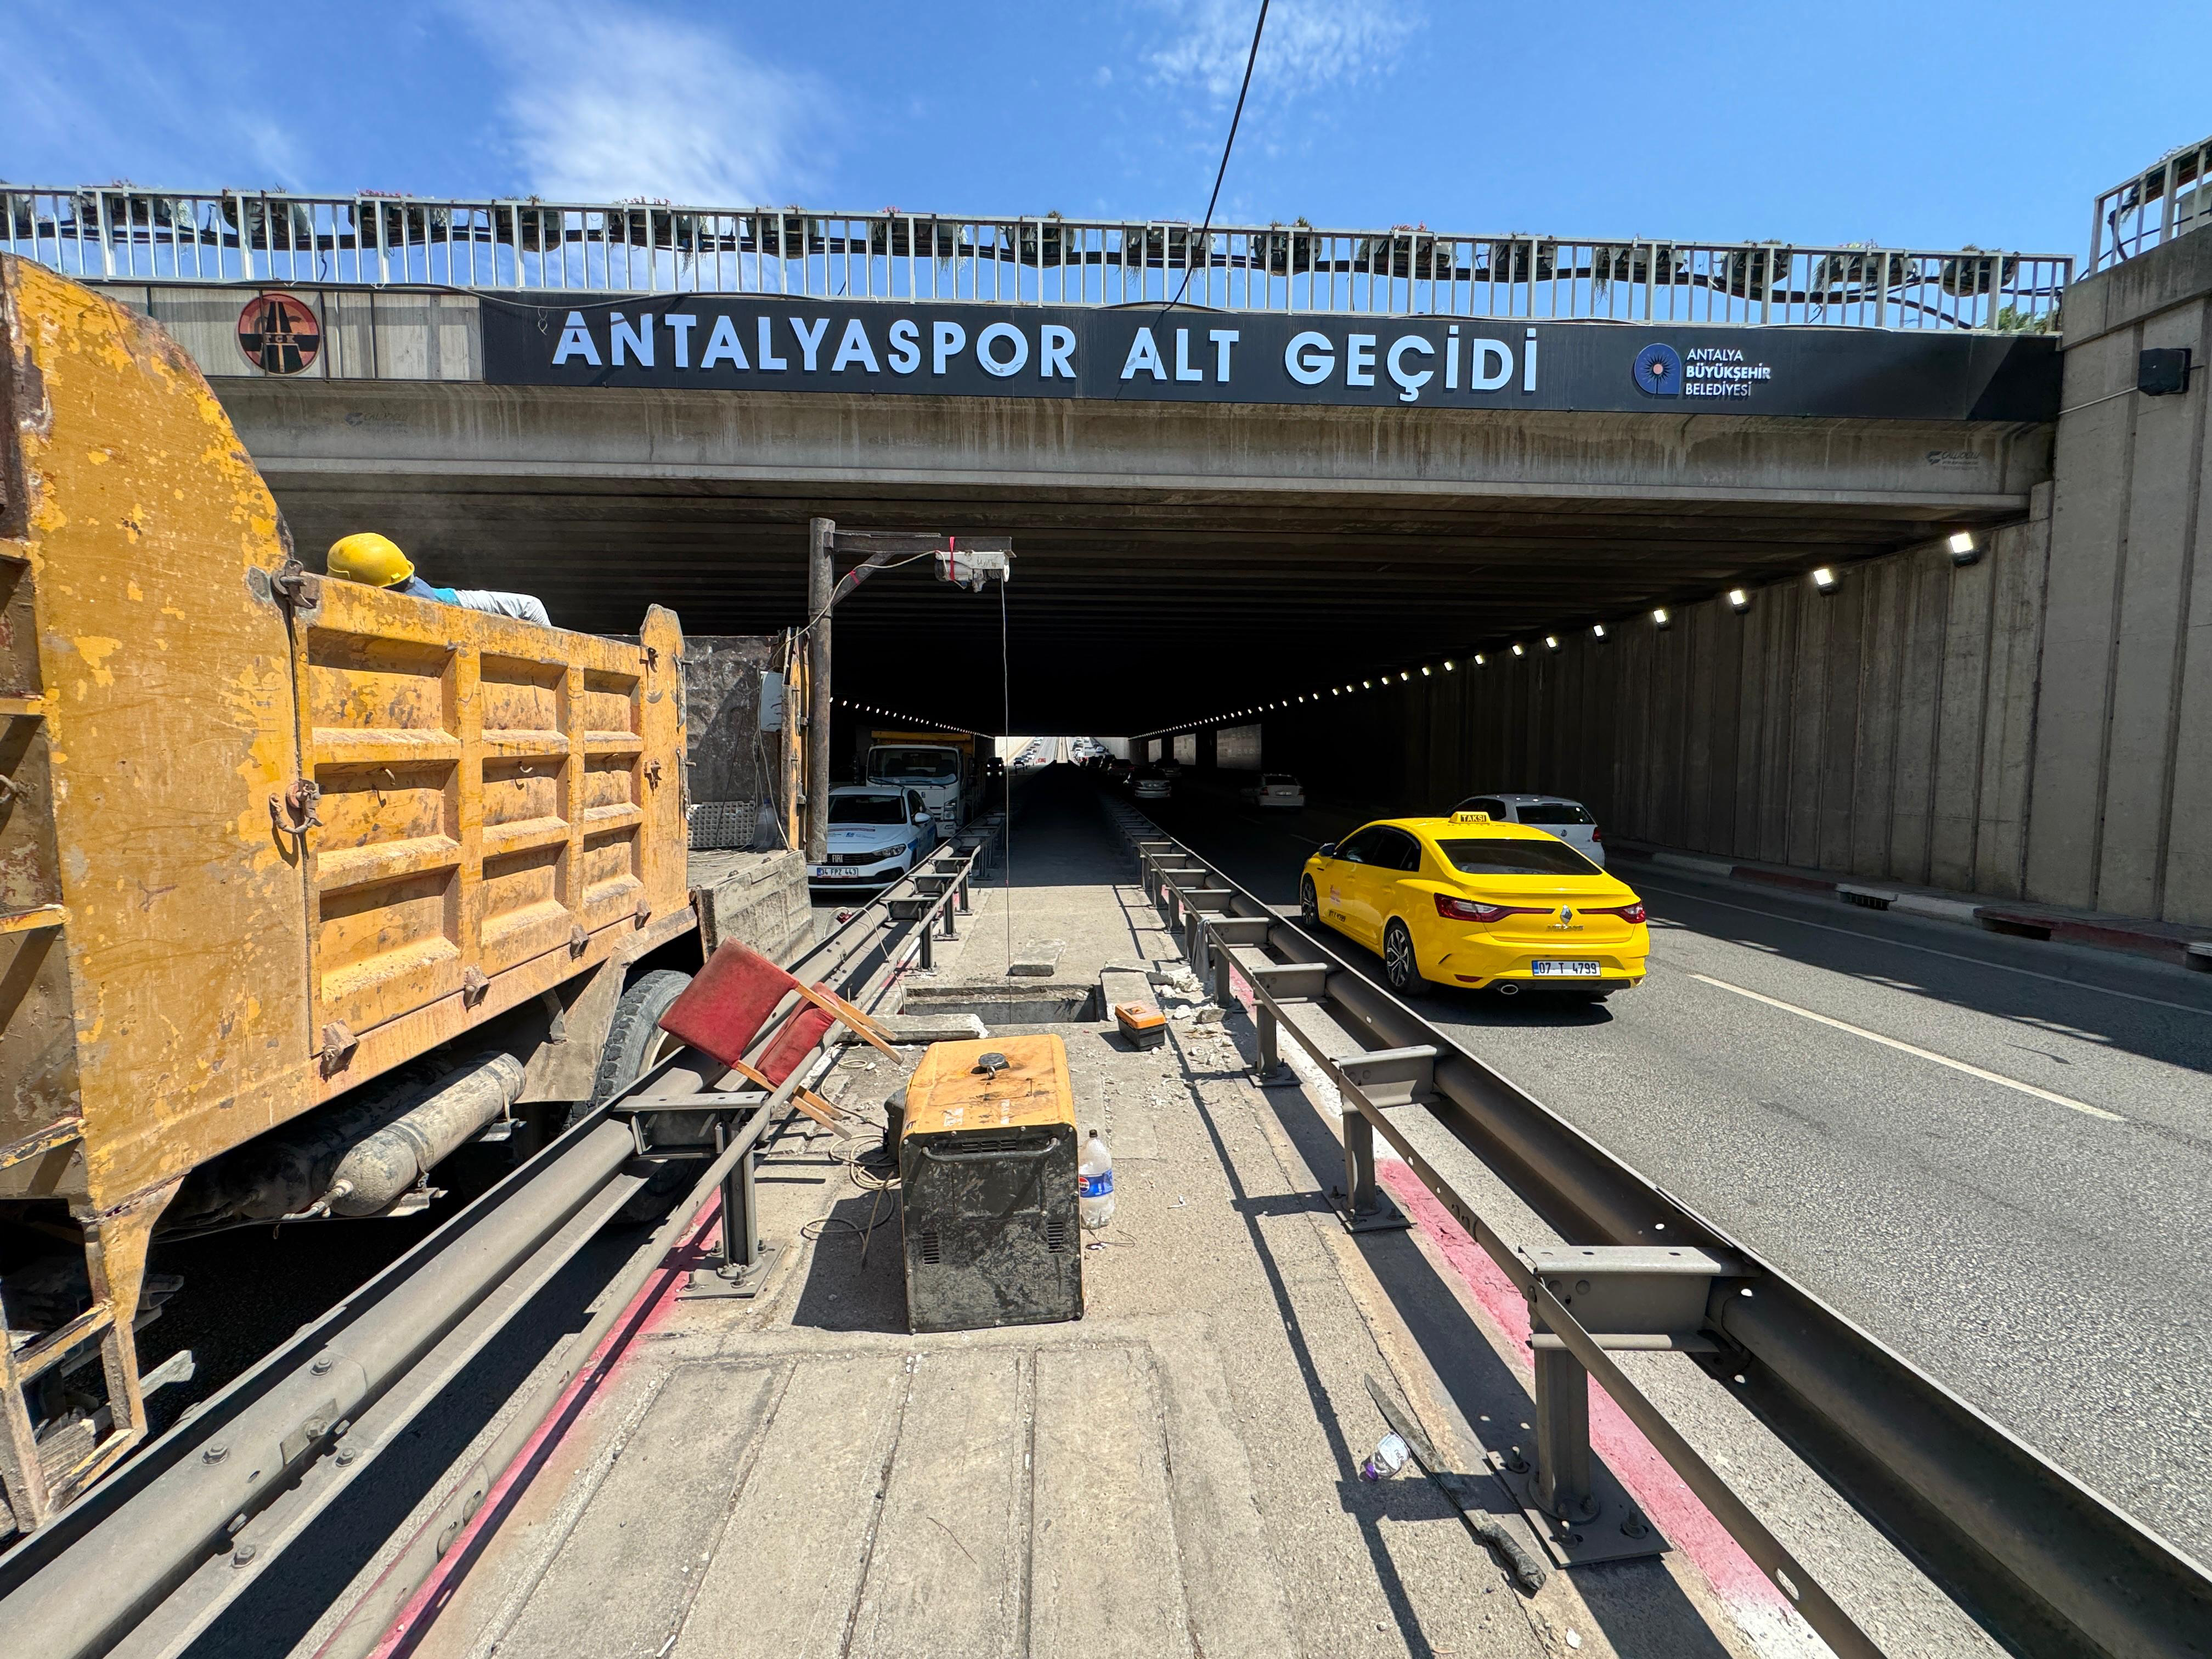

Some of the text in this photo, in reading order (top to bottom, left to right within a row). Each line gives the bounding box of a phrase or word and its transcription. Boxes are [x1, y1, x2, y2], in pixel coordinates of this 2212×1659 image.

[552, 311, 1537, 402] ANTALYASPOR ALT GEÇİDİ
[1686, 348, 1743, 361] ANTALYA
[1686, 363, 1771, 382] BÜYÜKŞEHİR
[1685, 381, 1752, 396] BELEDİYESİ
[1539, 962, 1597, 974] 07 T 4799
